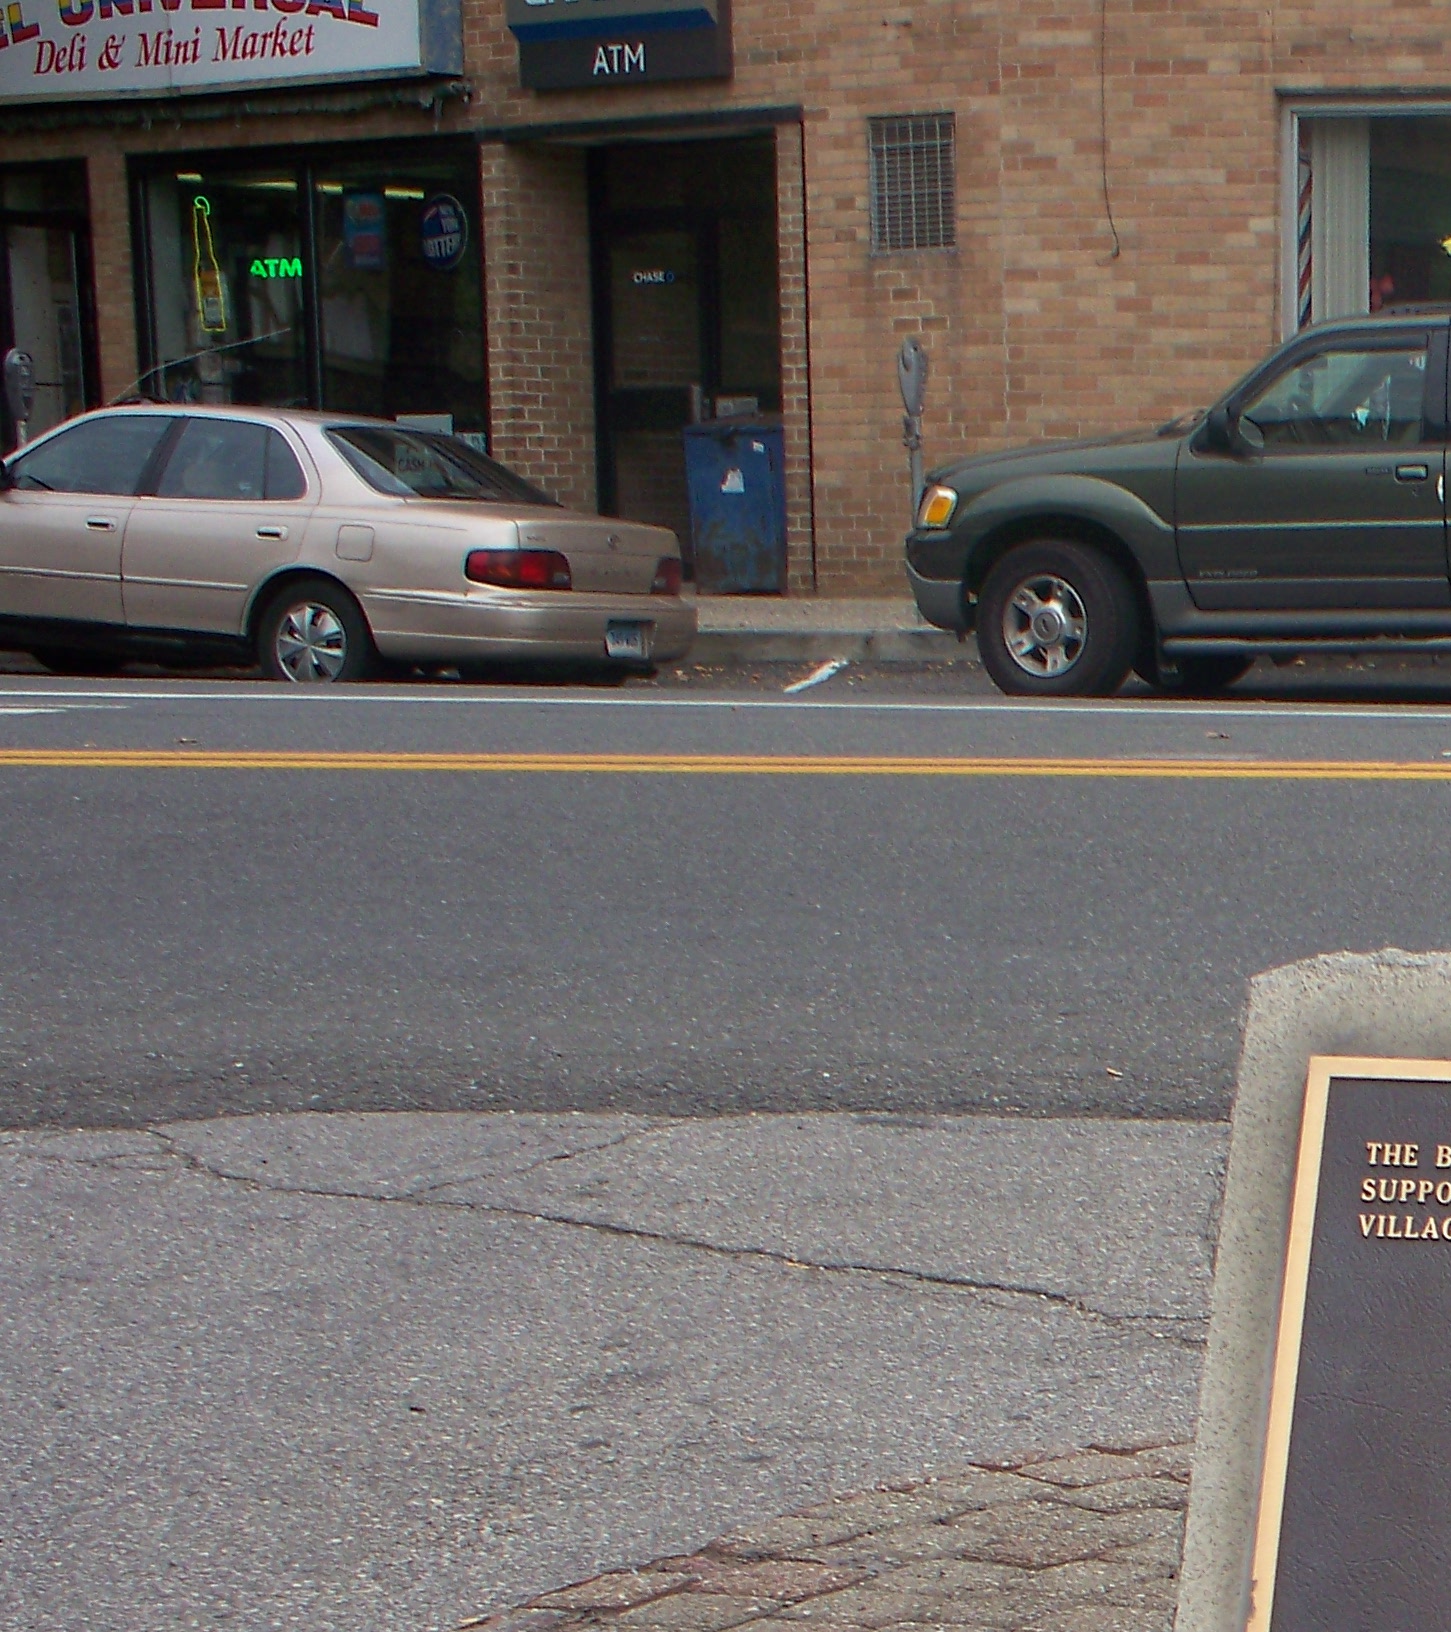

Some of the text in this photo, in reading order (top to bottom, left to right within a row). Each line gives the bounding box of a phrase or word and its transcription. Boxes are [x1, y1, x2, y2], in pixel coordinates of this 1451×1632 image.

[34, 16, 316, 75] Deli & Mini Market
[592, 42, 647, 76] ATM
[250, 257, 303, 279] ATM
[633, 270, 666, 284] CHASE
[1365, 1140, 1420, 1167] THE
